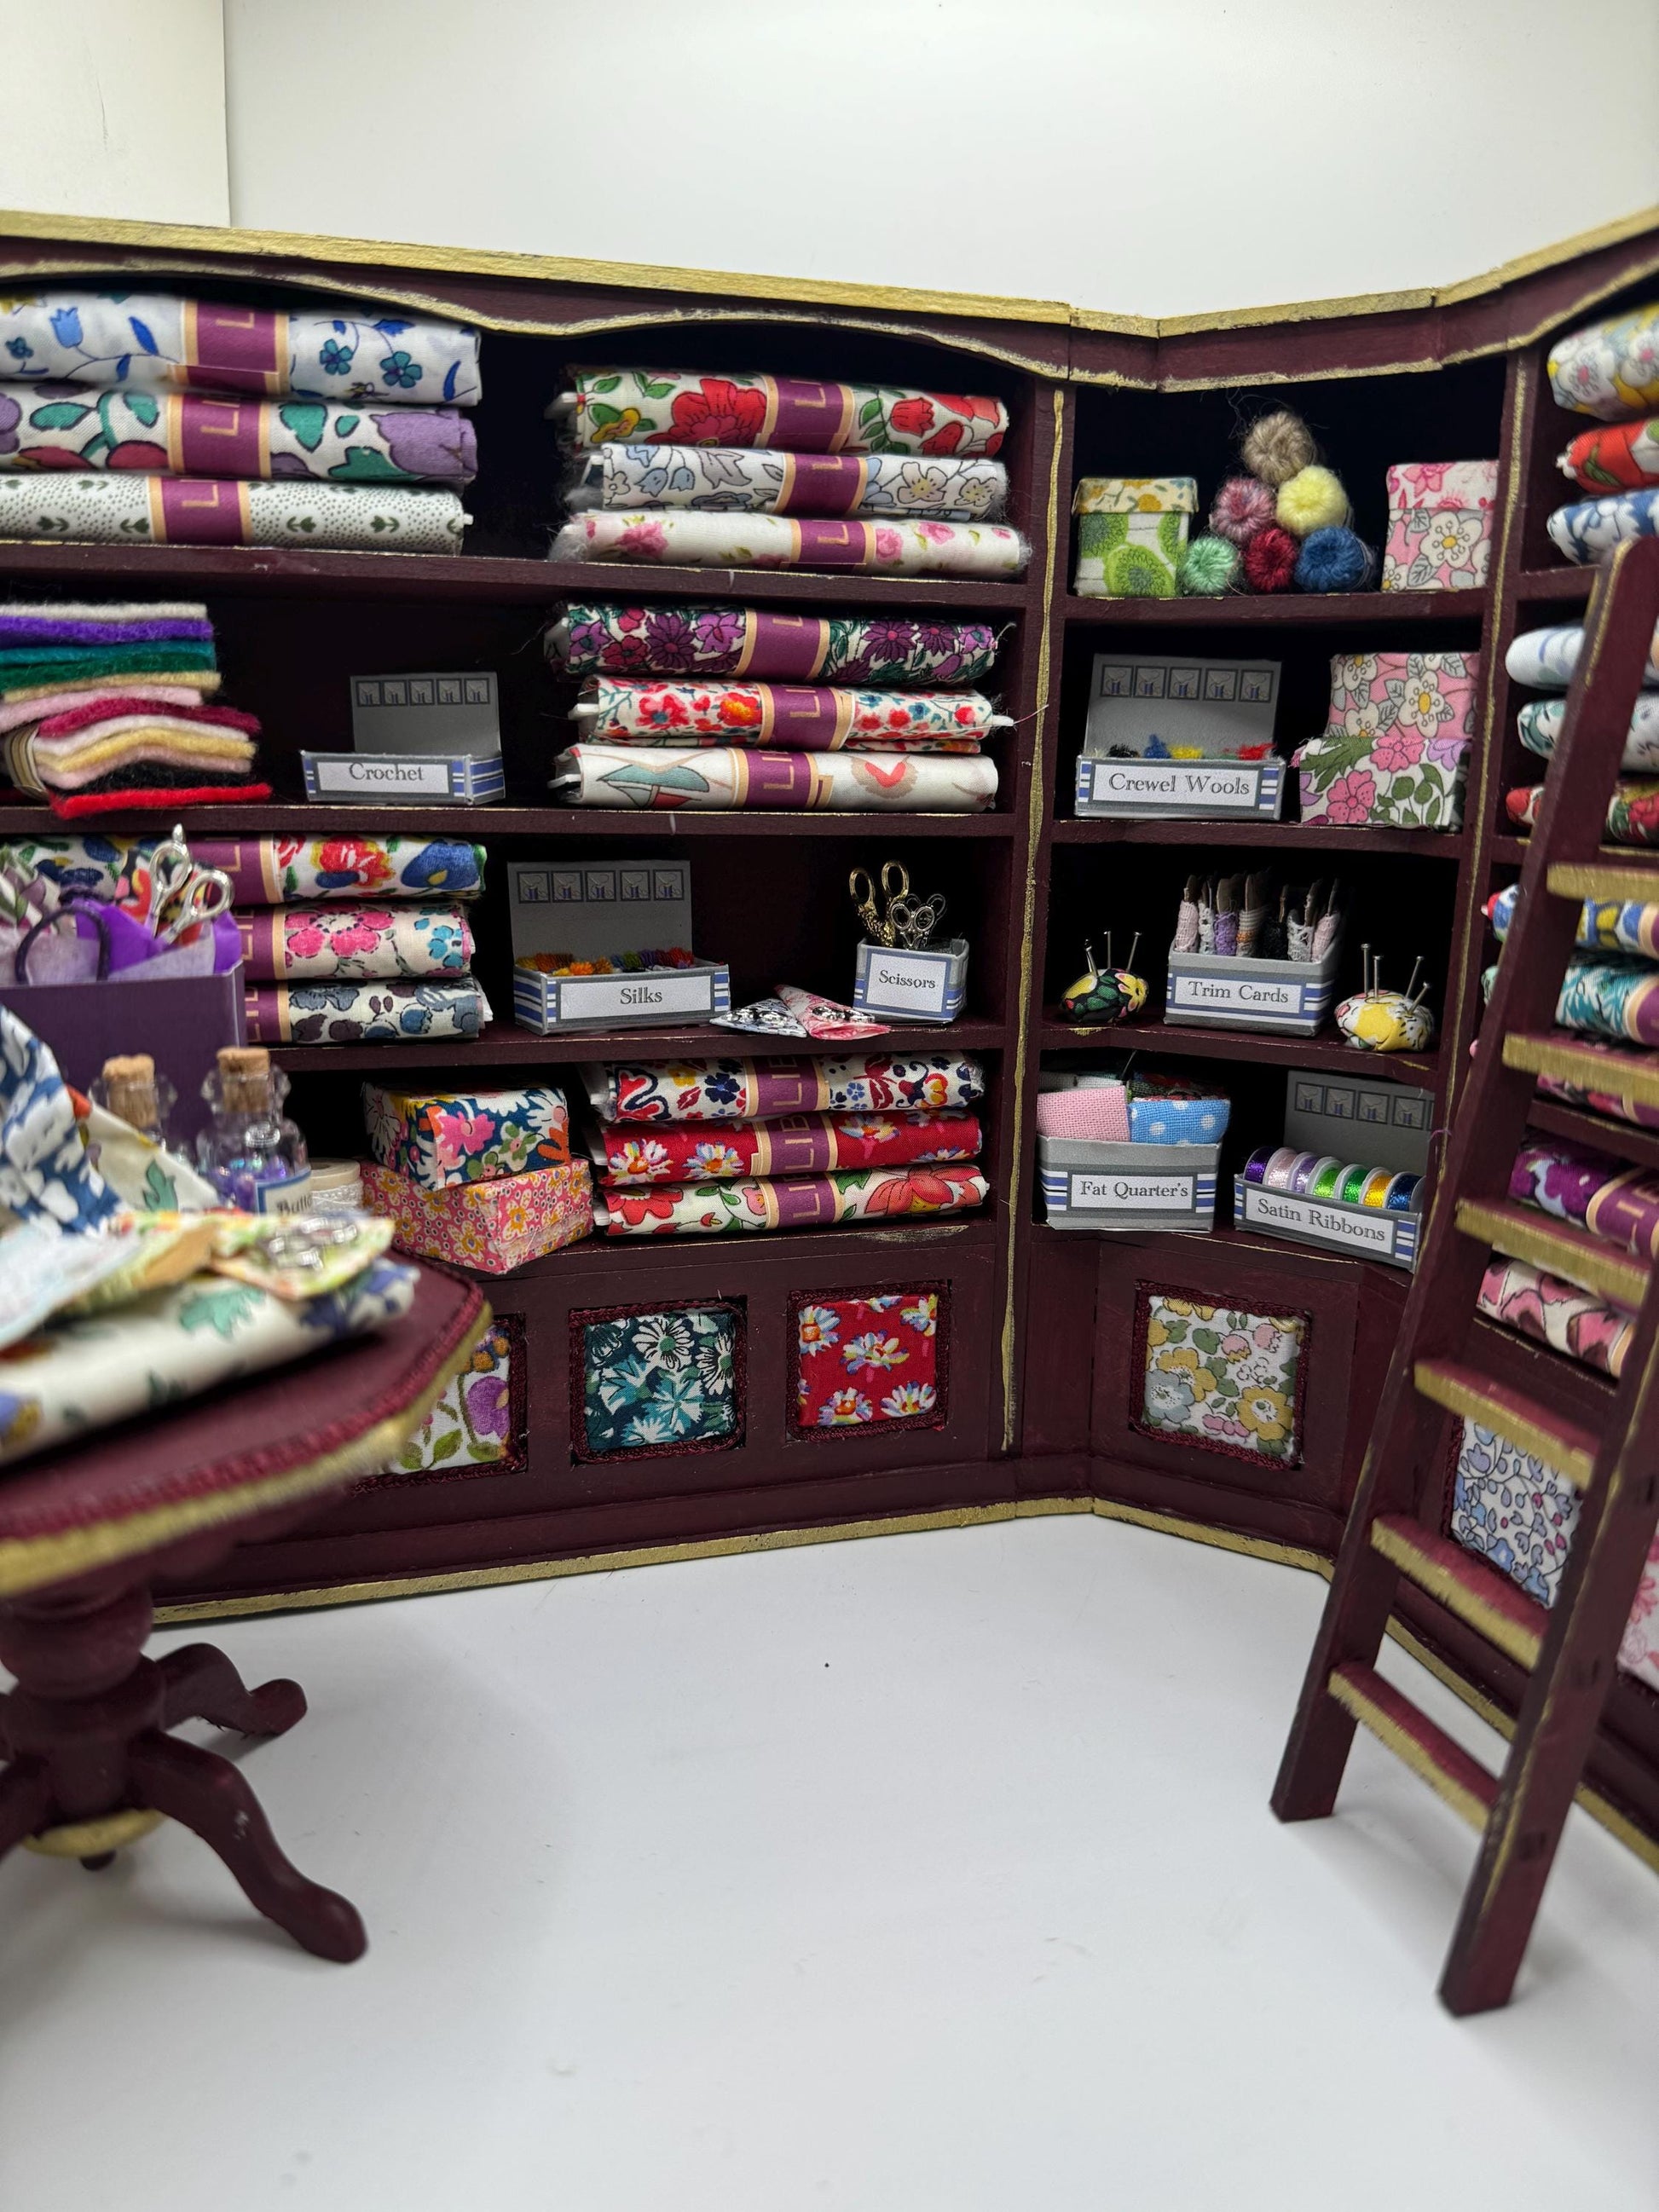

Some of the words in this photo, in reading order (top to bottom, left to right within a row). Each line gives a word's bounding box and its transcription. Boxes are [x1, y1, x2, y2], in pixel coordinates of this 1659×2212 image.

[349, 763, 425, 782] Crochet
[1108, 772, 1176, 796] Crewel
[1184, 774, 1251, 799] Wools
[879, 969, 936, 989] Scissors
[620, 987, 663, 1006] Silks
[1188, 981, 1231, 999] Trim
[1238, 984, 1289, 1003] Cards
[1080, 1180, 1107, 1196] Fat
[1113, 1181, 1189, 1199] Quarter's
[1257, 1198, 1302, 1222] Satin
[1307, 1209, 1385, 1242] Ribbons
